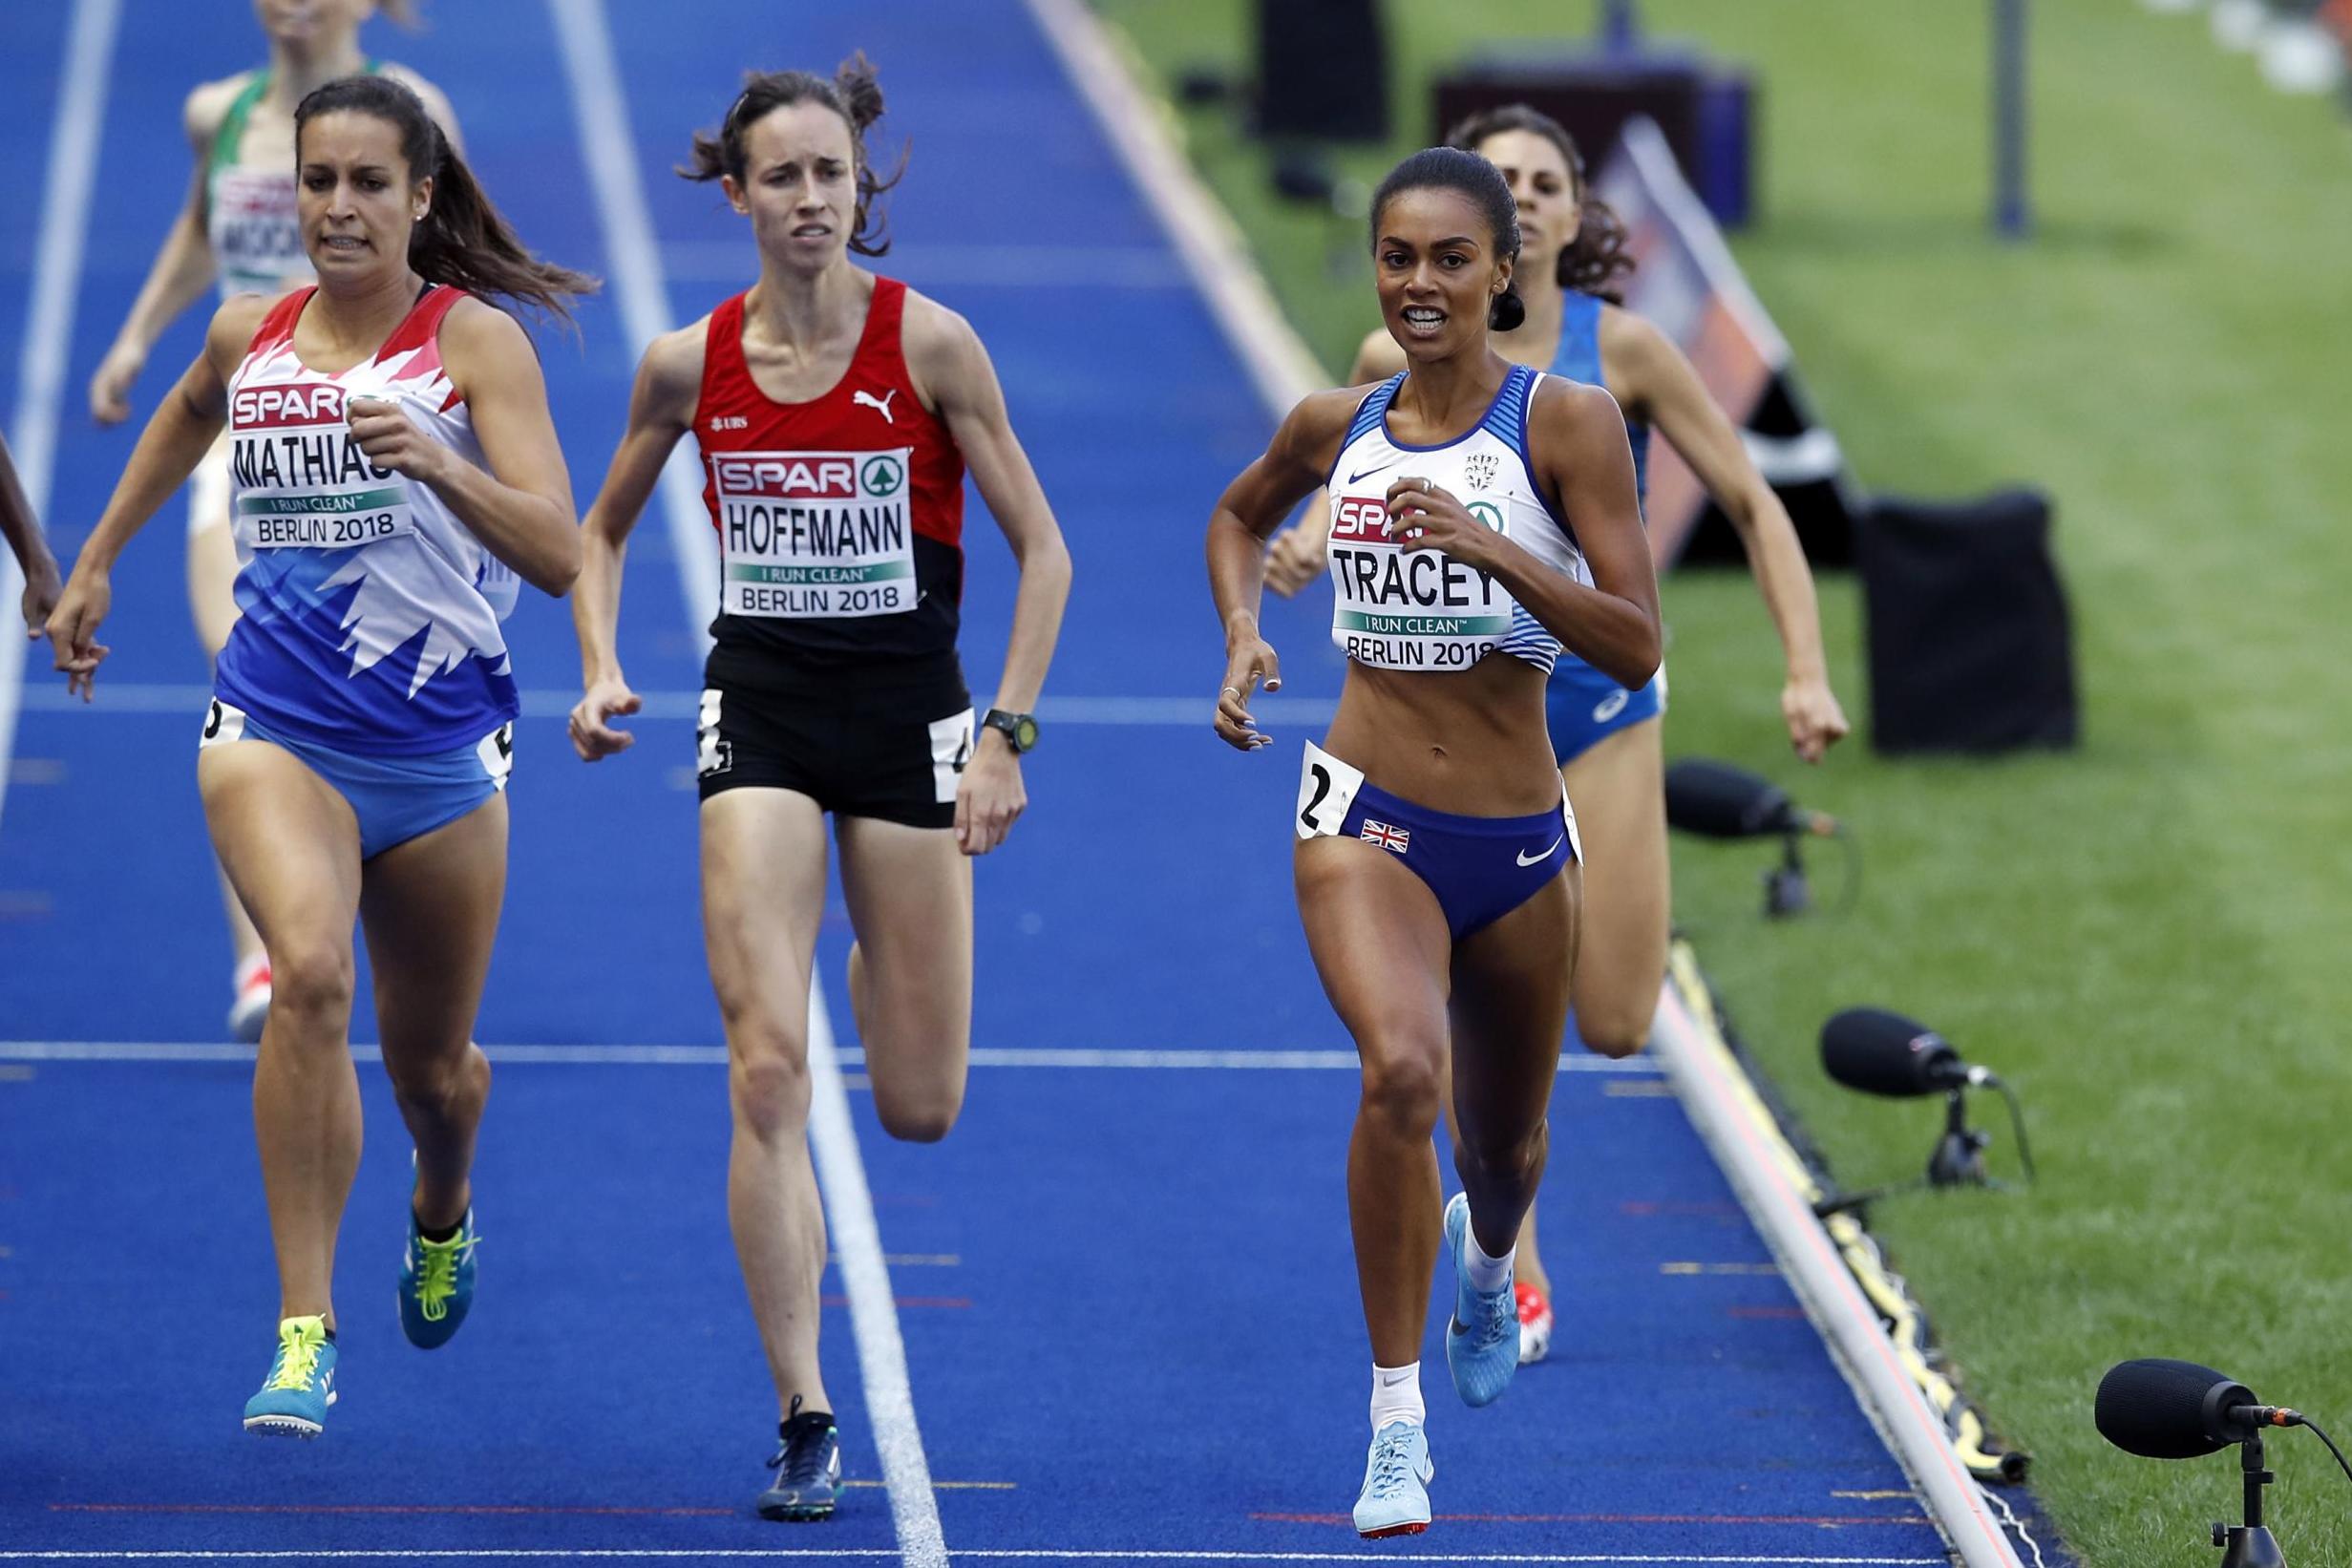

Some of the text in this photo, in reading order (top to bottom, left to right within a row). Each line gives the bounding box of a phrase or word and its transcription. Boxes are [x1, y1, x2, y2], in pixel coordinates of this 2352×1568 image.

[235, 388, 340, 424] SPAR
[723, 416, 748, 430] UBS
[720, 462, 855, 493] SPAR
[279, 498, 307, 512] RUN
[258, 513, 394, 541] BERLIN 2018
[728, 503, 903, 557] HOFFMANN
[771, 568, 806, 582] RUN
[1333, 549, 1496, 606] TRACEY
[742, 586, 900, 612] BERLIN 2018
[1371, 617, 1401, 632] RUN
[1347, 636, 1424, 665] BERLIN
[1300, 763, 1331, 831] 2
